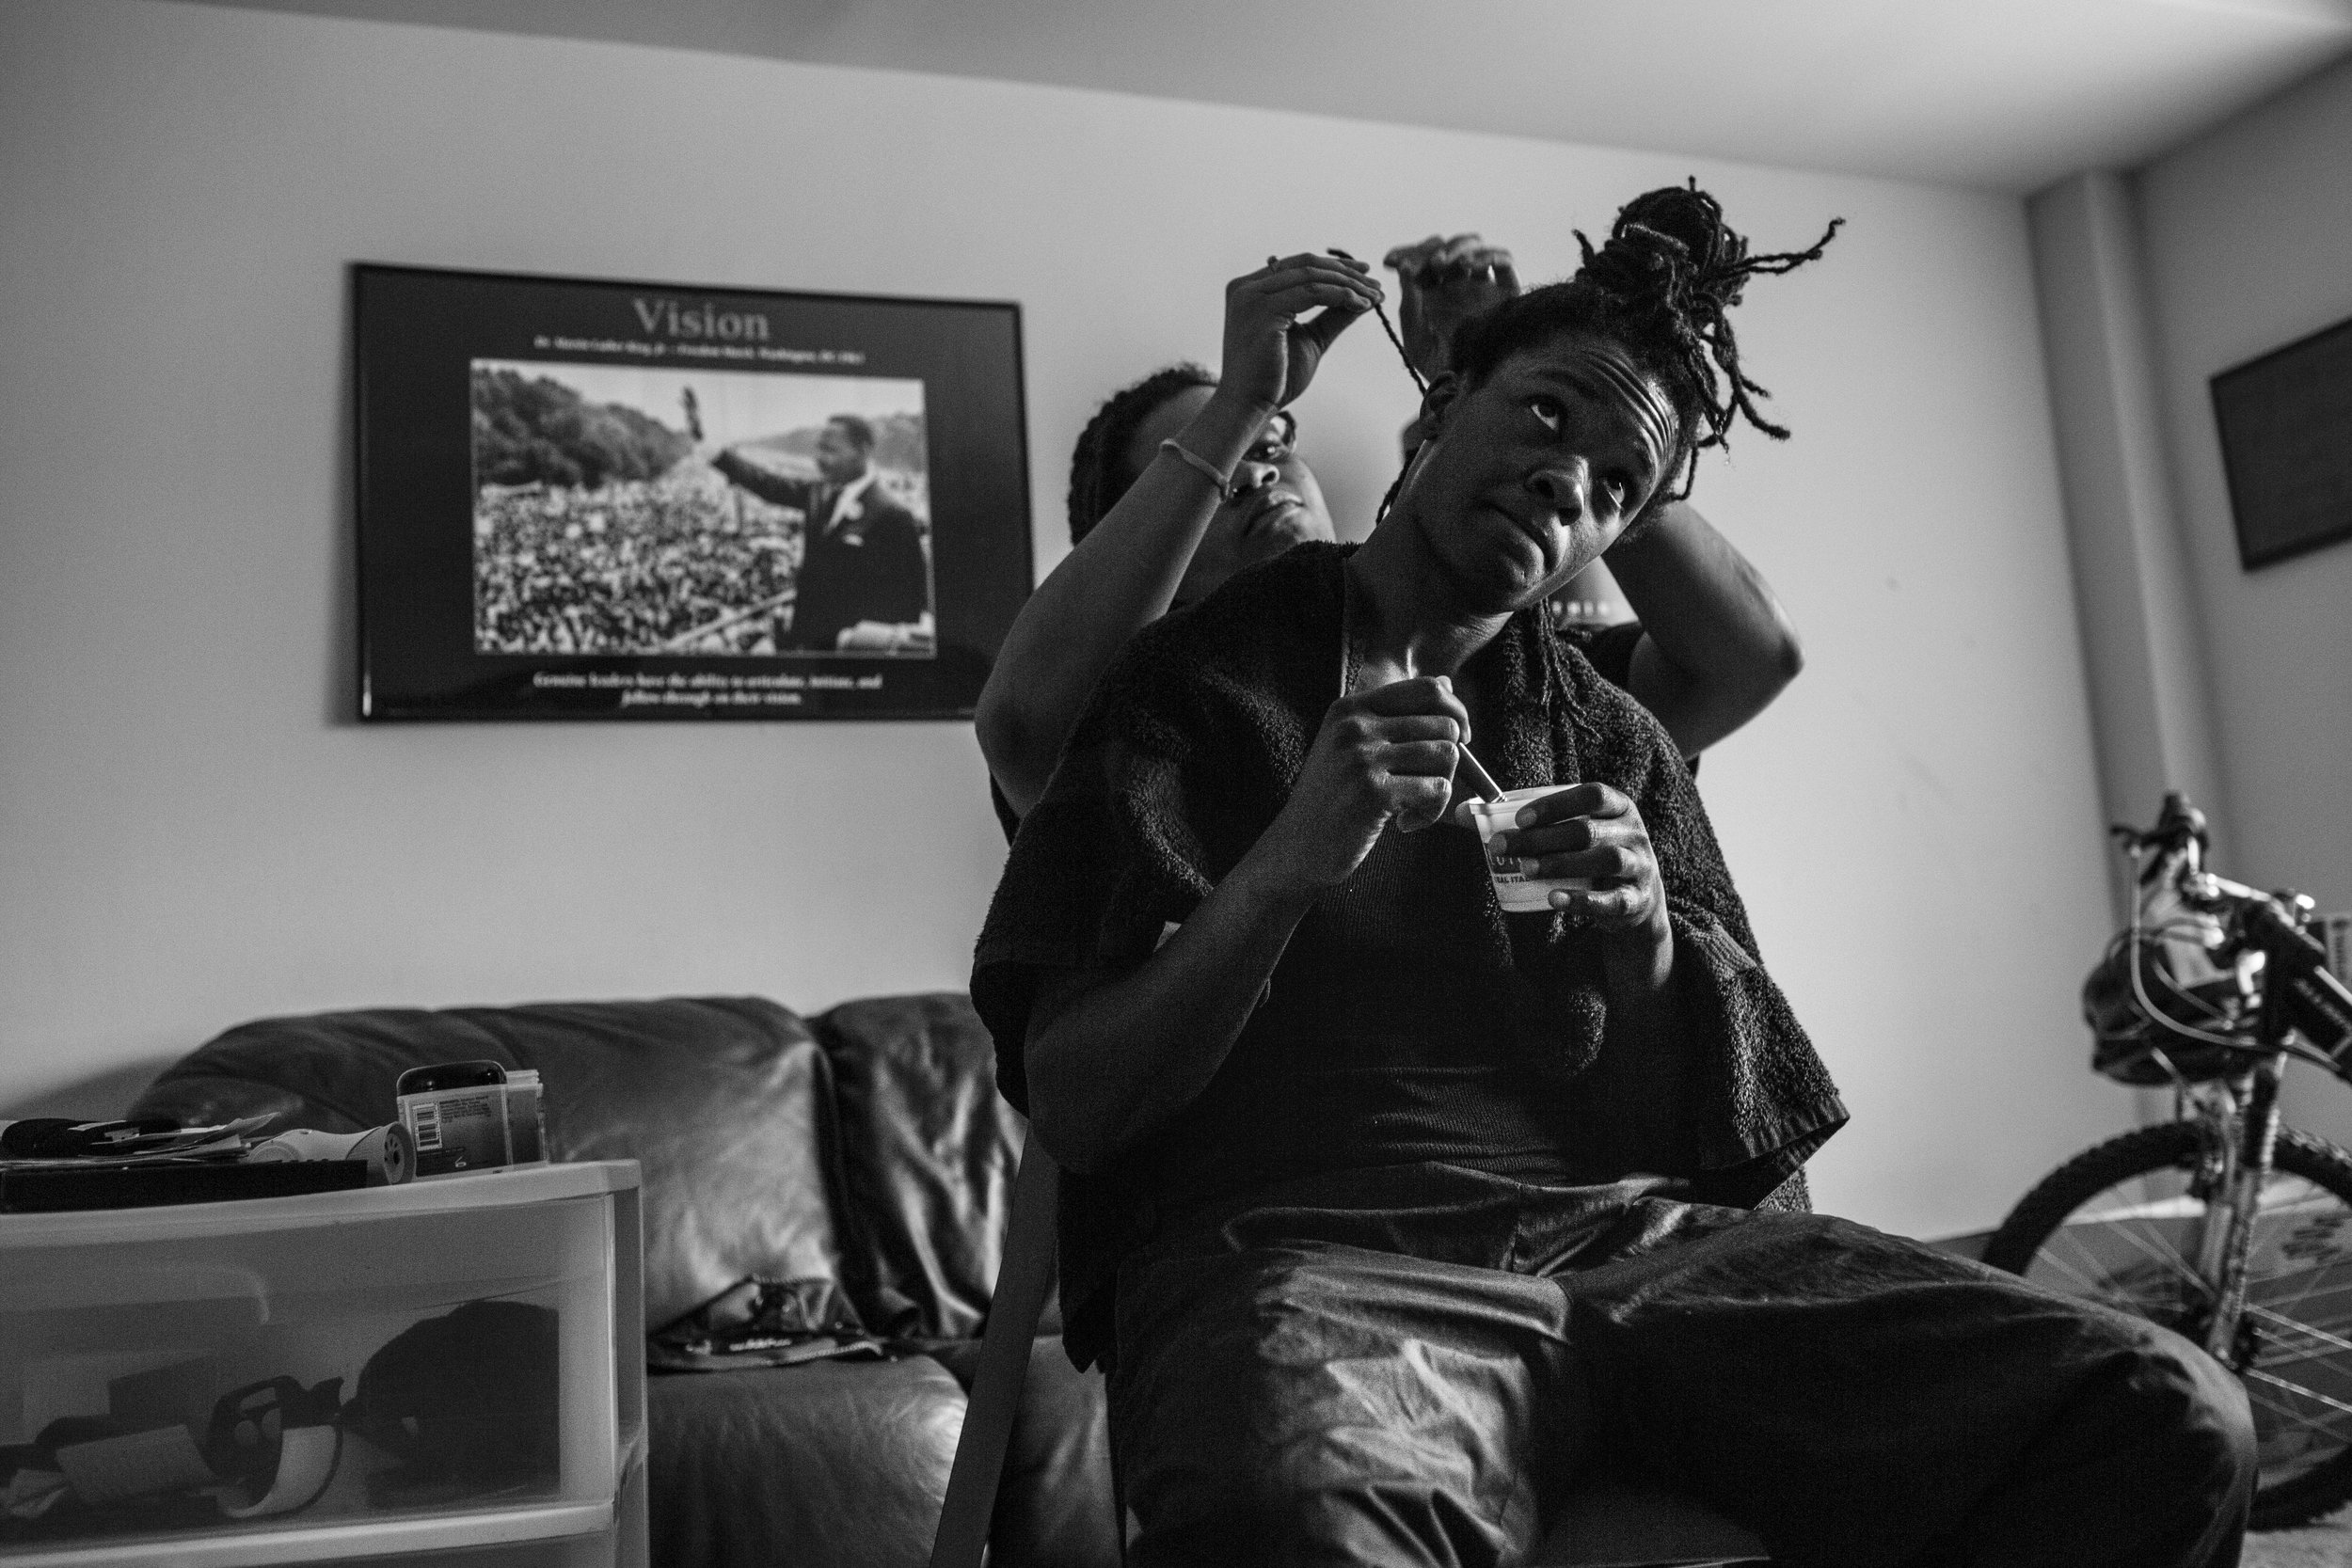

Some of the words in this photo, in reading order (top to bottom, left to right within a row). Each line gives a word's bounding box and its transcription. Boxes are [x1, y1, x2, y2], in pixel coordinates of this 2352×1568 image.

[631, 297, 770, 341] Vision
[667, 672, 688, 689] the
[856, 673, 883, 689] and
